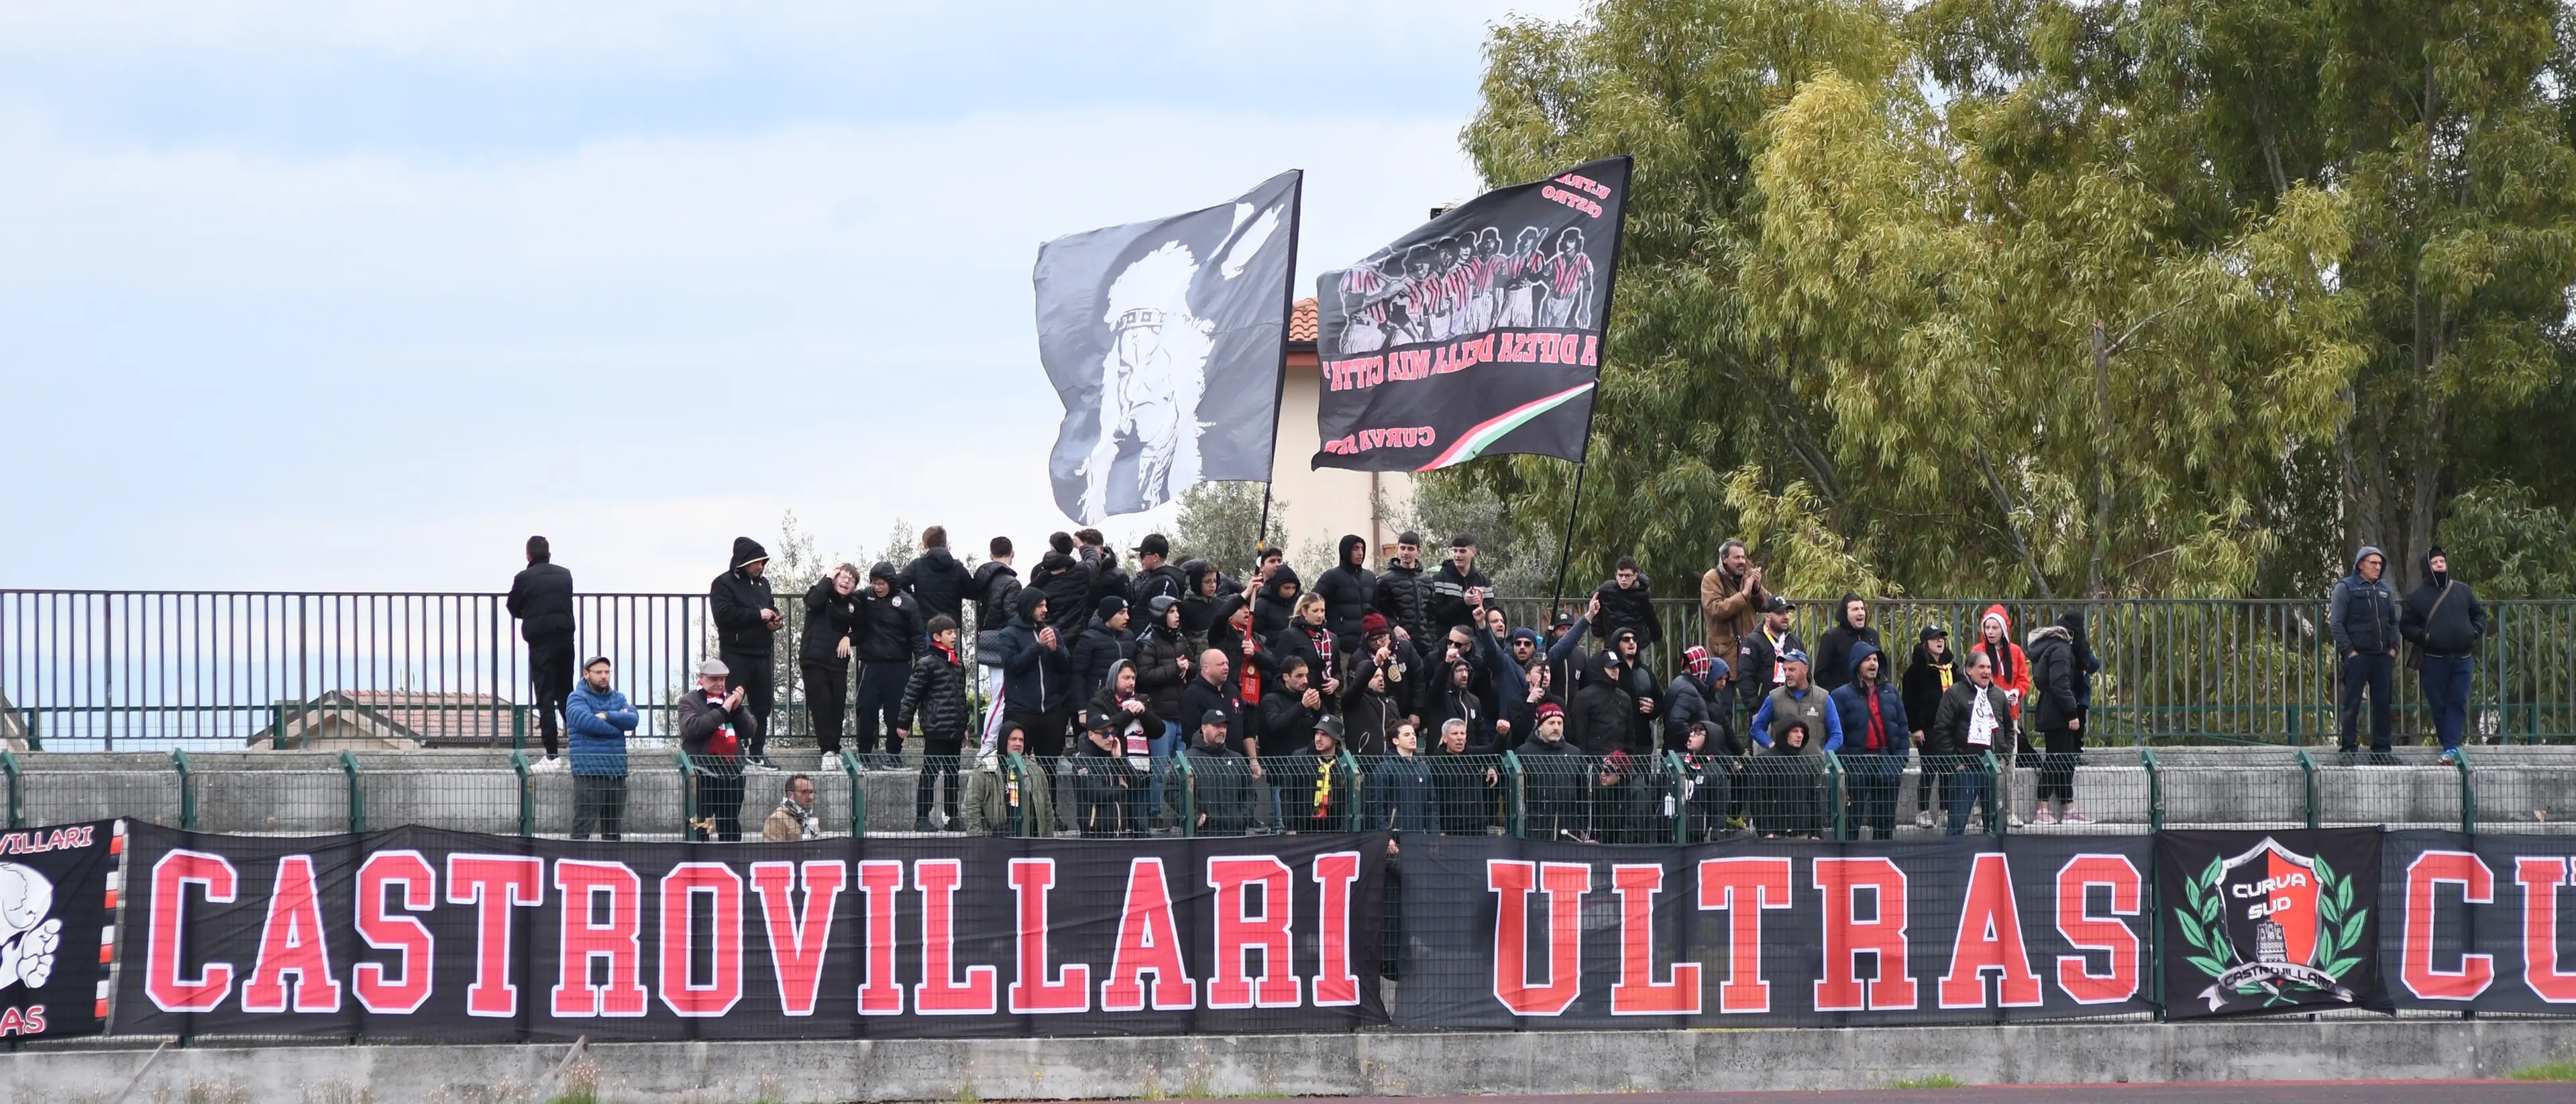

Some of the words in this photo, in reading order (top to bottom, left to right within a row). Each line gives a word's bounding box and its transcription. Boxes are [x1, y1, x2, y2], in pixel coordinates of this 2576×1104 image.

[2232, 873, 2307, 899] CURVA
[2248, 896, 2292, 920] SUD
[145, 849, 1361, 1017] CASTROVILLARI
[1487, 852, 2141, 1016] ULTRAS
